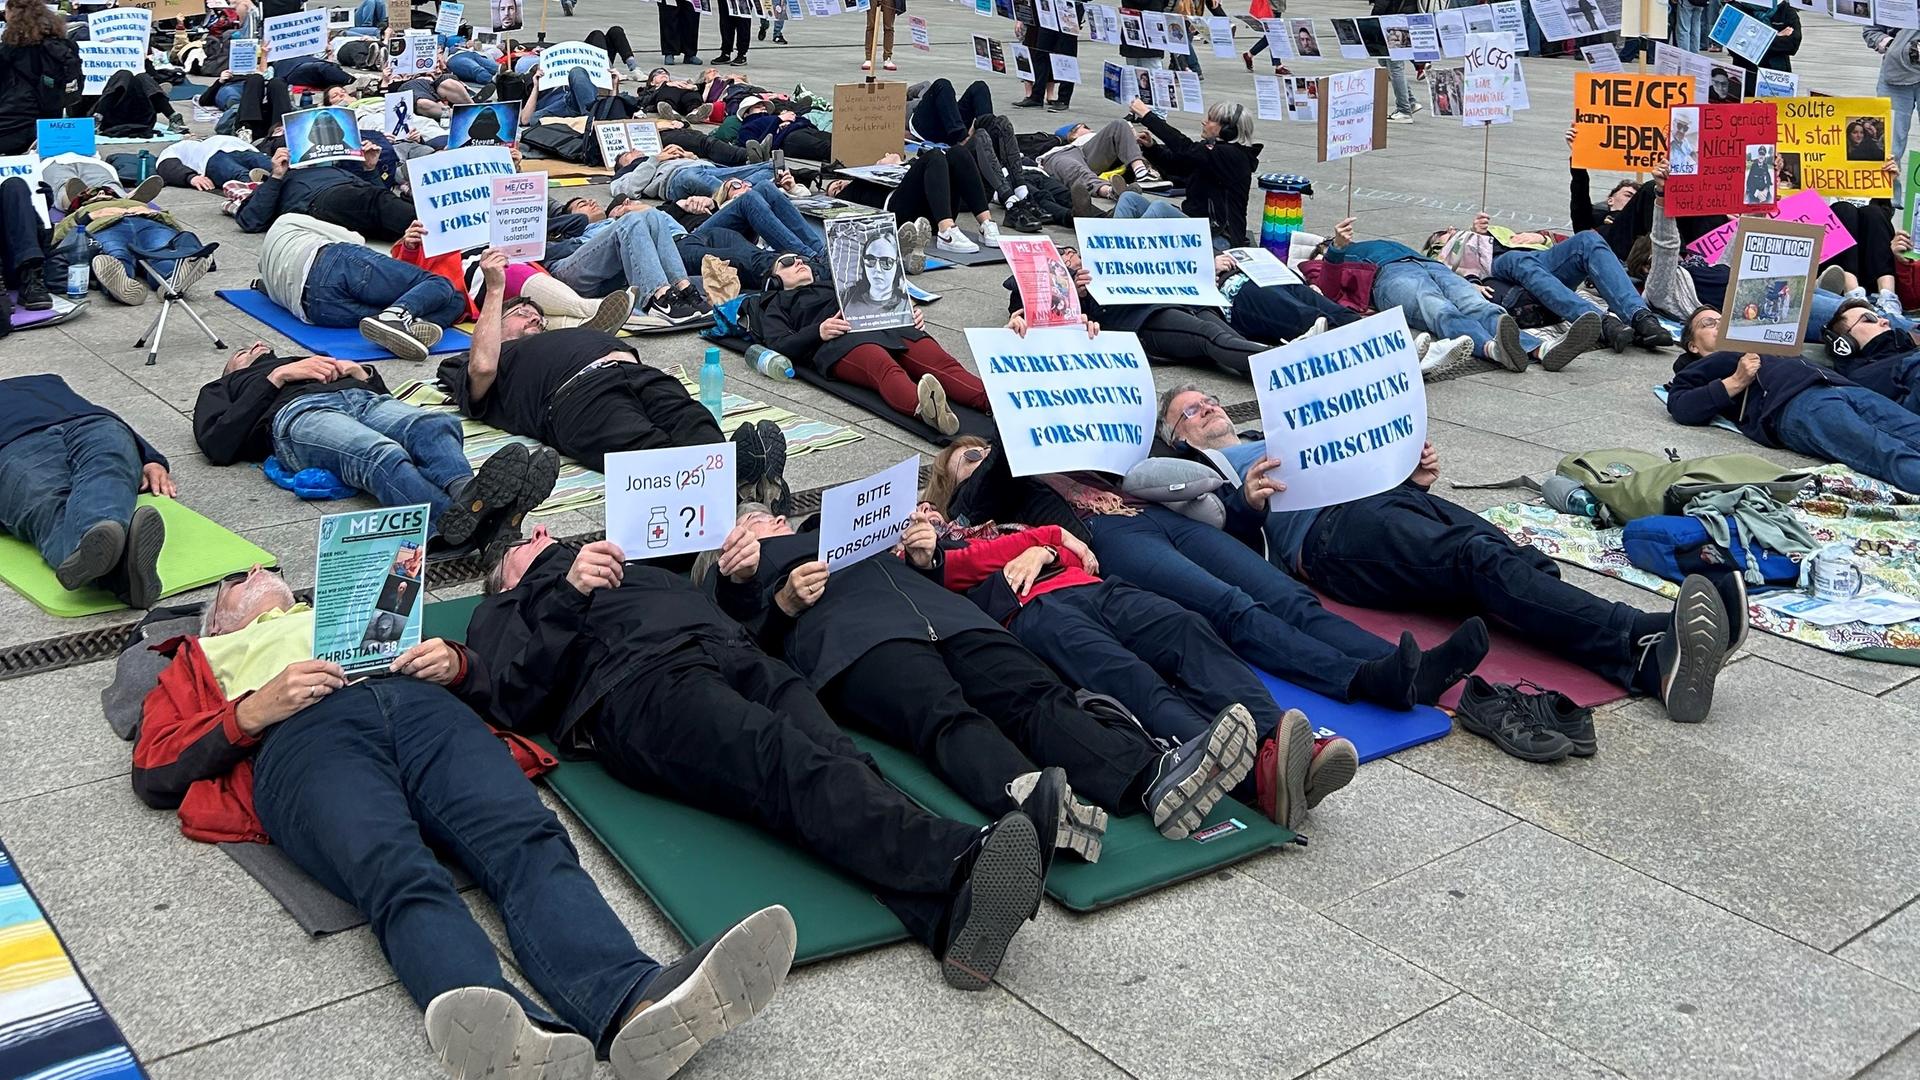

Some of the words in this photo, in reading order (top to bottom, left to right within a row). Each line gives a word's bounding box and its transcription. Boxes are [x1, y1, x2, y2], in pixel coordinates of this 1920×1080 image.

[92, 12, 149, 25] ANERKENNUNG
[268, 14, 324, 31] ANERKENNUNG
[95, 23, 146, 36] VERSORGUNG
[271, 25, 321, 42] VERSORGUNG
[80, 46, 140, 55] NERKENNUNG
[275, 37, 320, 53] FORSCHUNG
[544, 47, 606, 61] ANERKENNUNG
[1464, 41, 1513, 73] ME/CFS
[84, 60, 137, 69] ERSORGUNG
[546, 59, 604, 69] VERSORGUNG
[1590, 78, 1688, 109] ME/CFS
[1575, 108, 1611, 124] kann
[1704, 108, 1723, 130] Es
[1729, 107, 1772, 138] genügt
[471, 138, 495, 146] Steven
[1599, 124, 1668, 151] JEDEN
[1776, 122, 1801, 145] EN,
[1805, 124, 1843, 146] statt
[315, 143, 344, 154] Steven
[1803, 151, 1826, 162] nur
[1623, 150, 1666, 167] treff
[0, 164, 33, 177] UNG
[420, 161, 514, 187] ANERKENNUNG
[1670, 161, 1694, 174] ME/CFS
[1703, 165, 1715, 176] zu
[1803, 164, 1893, 190] ÜBERLEBEN
[504, 182, 535, 192] ME/CFS
[1670, 182, 1695, 193] dass
[1698, 179, 1712, 192] ihr
[1714, 183, 1733, 193] uns
[428, 185, 491, 209] VERSOR
[1675, 195, 1695, 210] hört
[1705, 194, 1728, 208] seht
[510, 205, 543, 215] FORDERN
[441, 210, 490, 233] FORSC
[498, 215, 540, 225] Versorgung
[510, 225, 528, 233] statt
[1086, 233, 1203, 249] ANERKENNUNG
[1745, 235, 1764, 252] ICH
[1764, 237, 1784, 255] BIN
[1782, 239, 1812, 257] NOCH
[1094, 260, 1198, 275] VERSORGUNG
[1750, 254, 1771, 272] DA!
[1106, 285, 1200, 296] FORSCHUNG
[989, 352, 1139, 374] ANERKENNUNG
[1268, 329, 1407, 392] ANERKENNUNG
[1007, 386, 1143, 410] VERSORGUNG
[1283, 371, 1410, 430] VERSORGUNG
[1029, 422, 1143, 447] FORSCHUNG
[1298, 414, 1414, 470] FORSCHUNG
[625, 475, 672, 492] Jonas
[676, 467, 706, 491] (25)
[705, 453, 724, 471] 28
[857, 481, 892, 507] BITTE
[349, 510, 424, 535] ME/CFS
[853, 504, 891, 532] MEHR
[826, 518, 911, 564] FORSCHUNG
[317, 643, 380, 662] CHRISTIAN
[383, 640, 398, 654] 38
